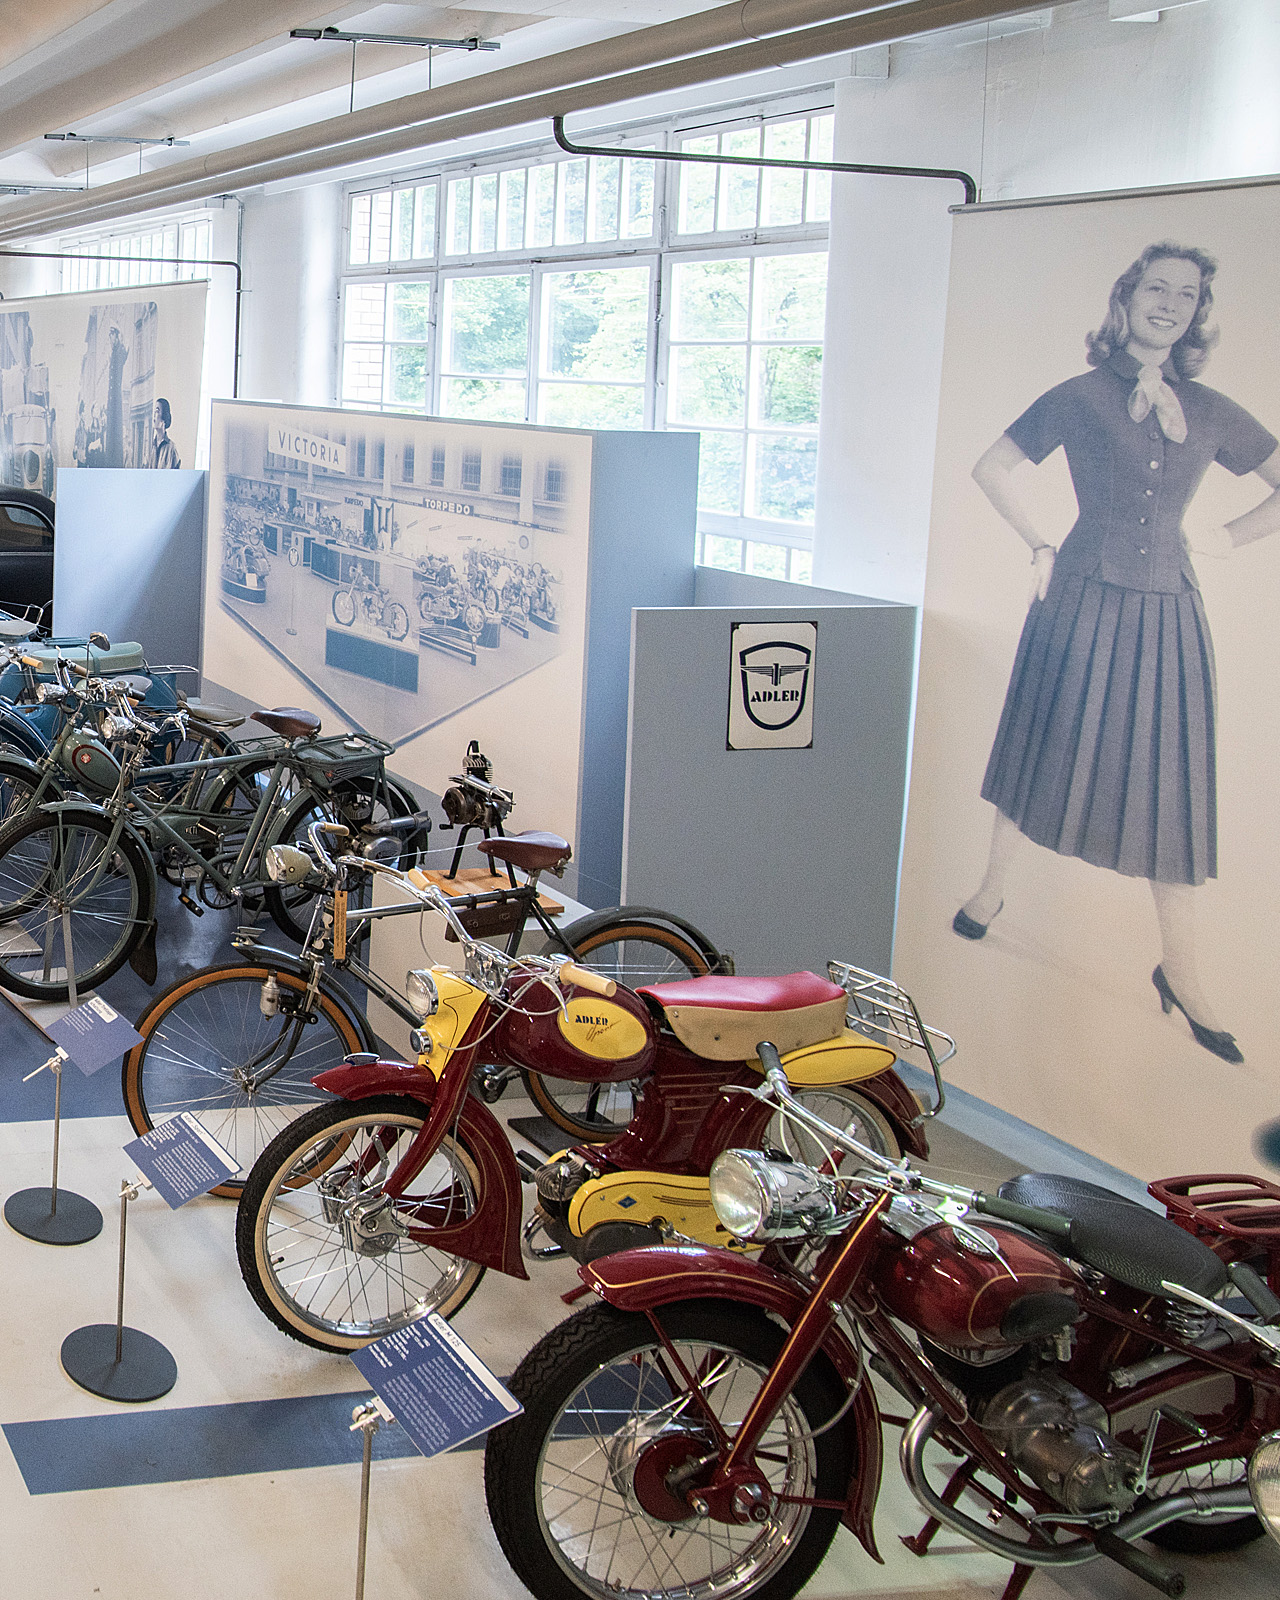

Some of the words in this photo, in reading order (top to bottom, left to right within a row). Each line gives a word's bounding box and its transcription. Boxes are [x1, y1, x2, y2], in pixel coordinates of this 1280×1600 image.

[278, 430, 339, 465] VICTORIA
[425, 498, 471, 515] TORPEDO
[750, 690, 800, 702] ADLER
[575, 1015, 609, 1026] ADLER
[431, 1316, 448, 1332] Adler
[448, 1336, 462, 1347] 125
